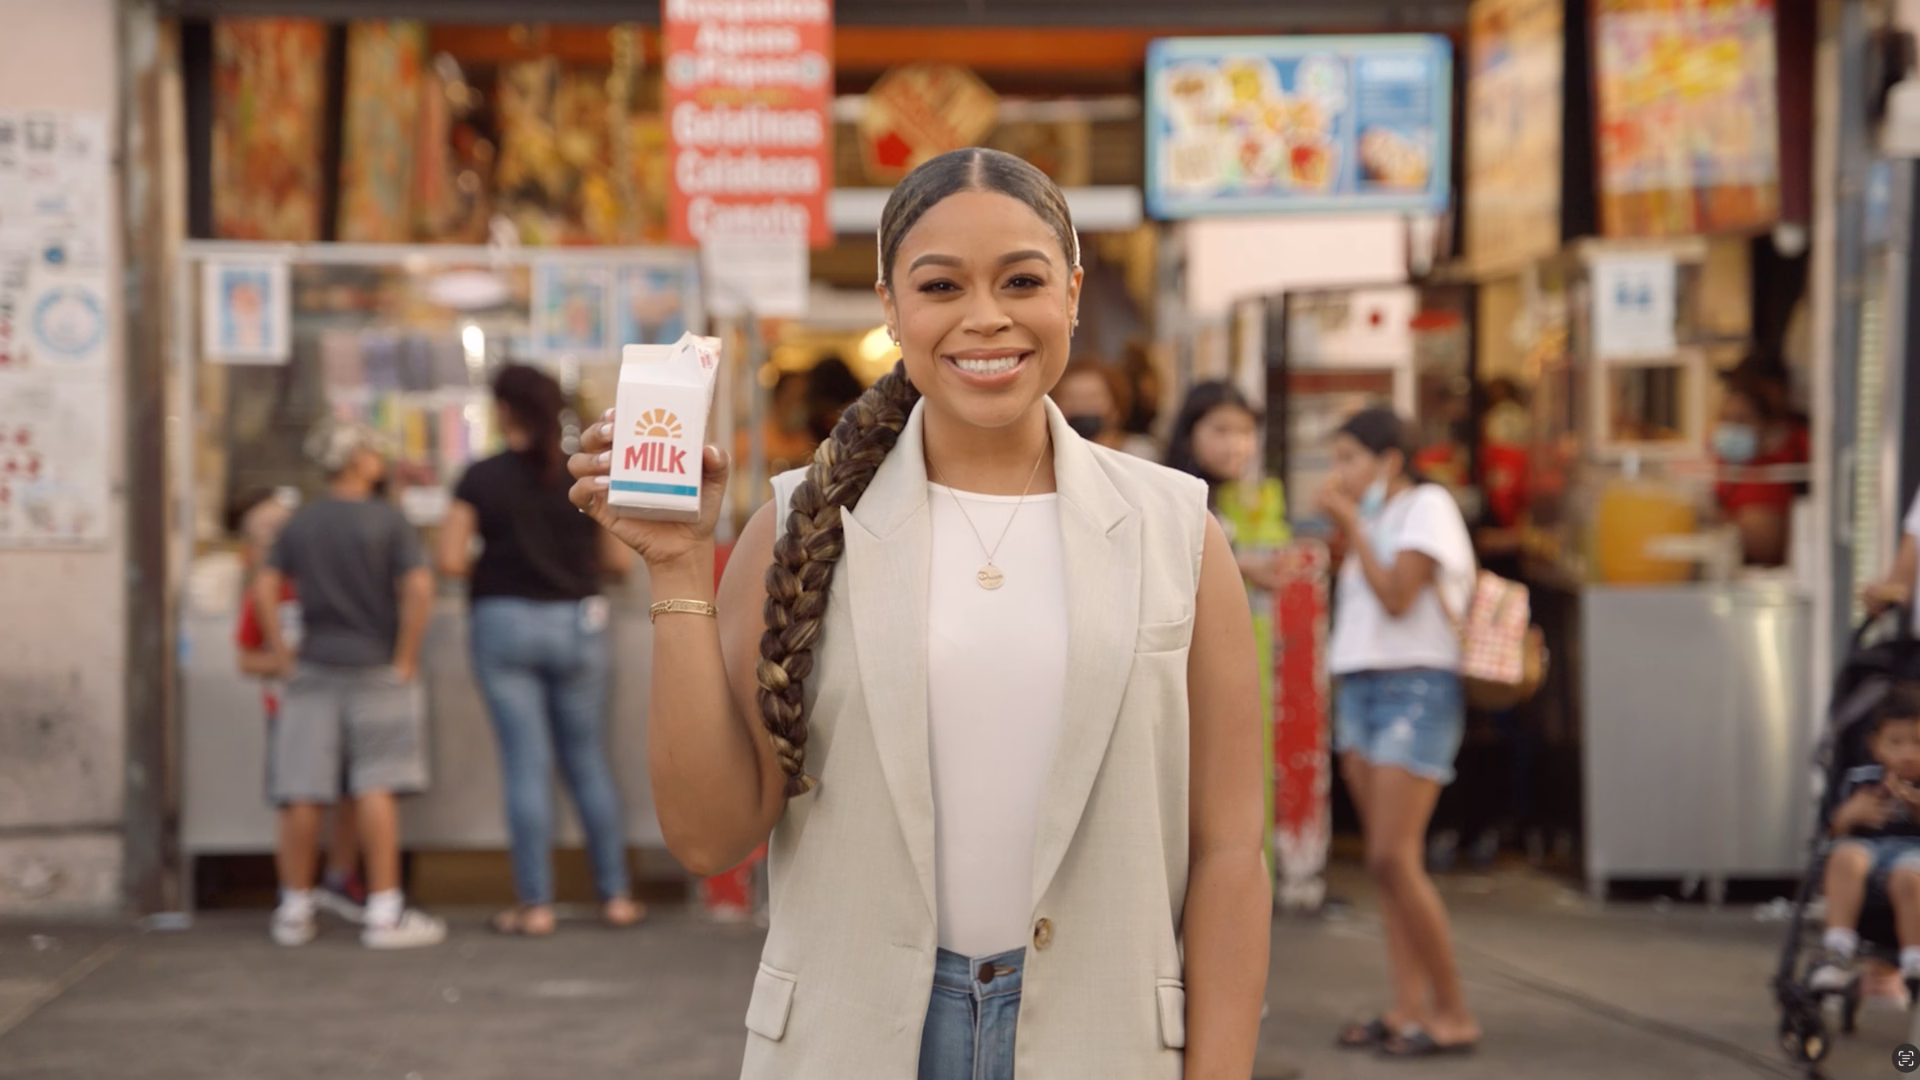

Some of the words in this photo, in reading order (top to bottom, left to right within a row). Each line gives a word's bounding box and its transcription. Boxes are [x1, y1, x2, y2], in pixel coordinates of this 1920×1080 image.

[672, 103, 823, 147] Gelatinas
[676, 150, 820, 194] Calabaza
[624, 442, 687, 475] MILK
